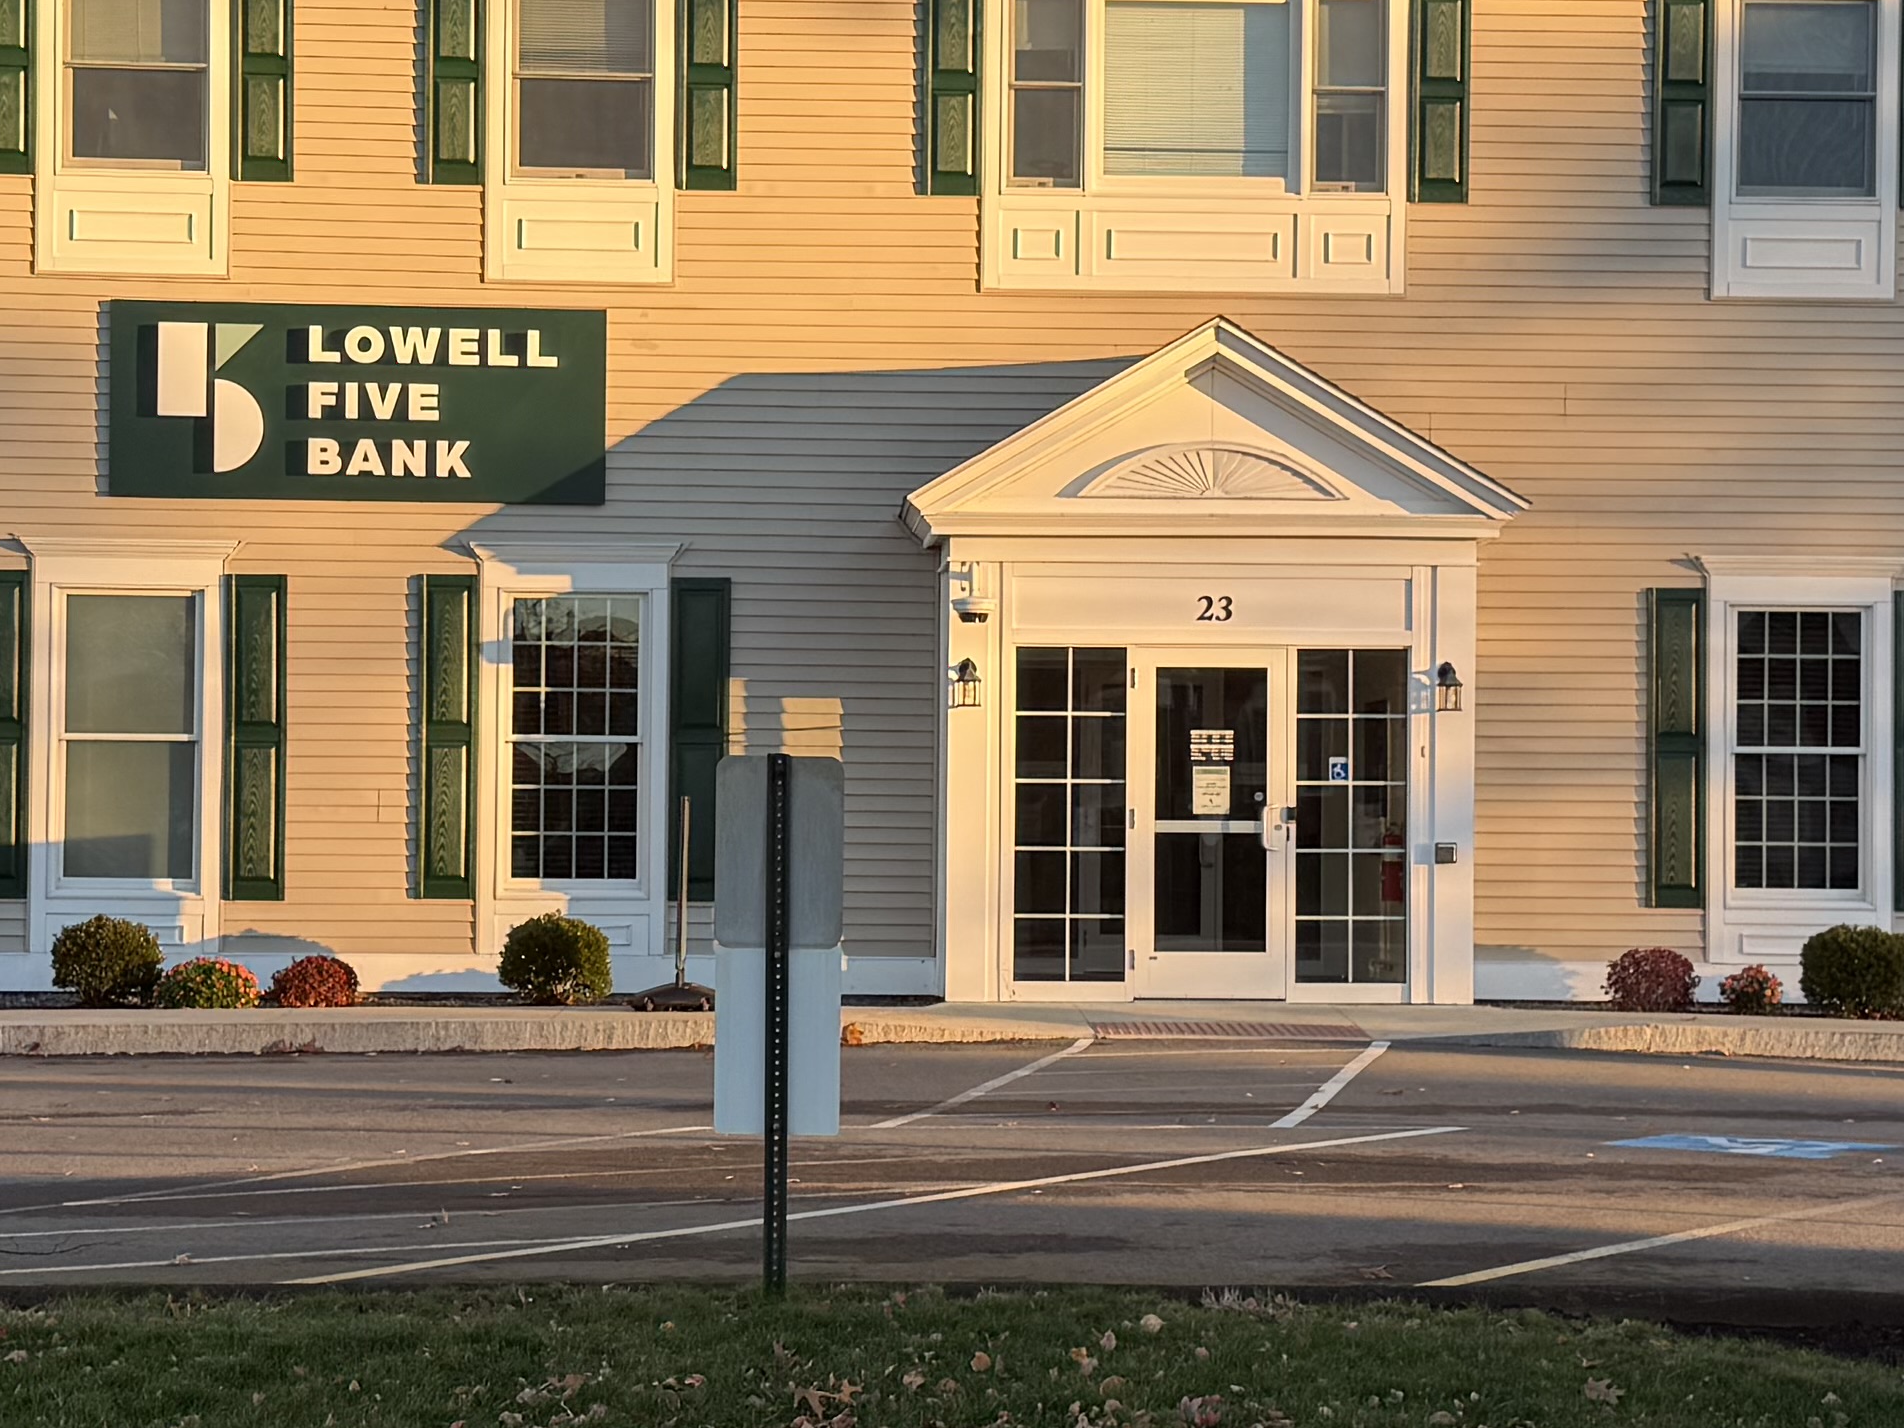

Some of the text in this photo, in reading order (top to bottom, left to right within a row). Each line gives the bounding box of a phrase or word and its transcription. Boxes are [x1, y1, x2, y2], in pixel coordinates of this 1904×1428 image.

[308, 324, 559, 368] LOWELL
[307, 381, 440, 421] FIVE
[307, 437, 472, 478] BANK
[1196, 595, 1233, 622] 23
